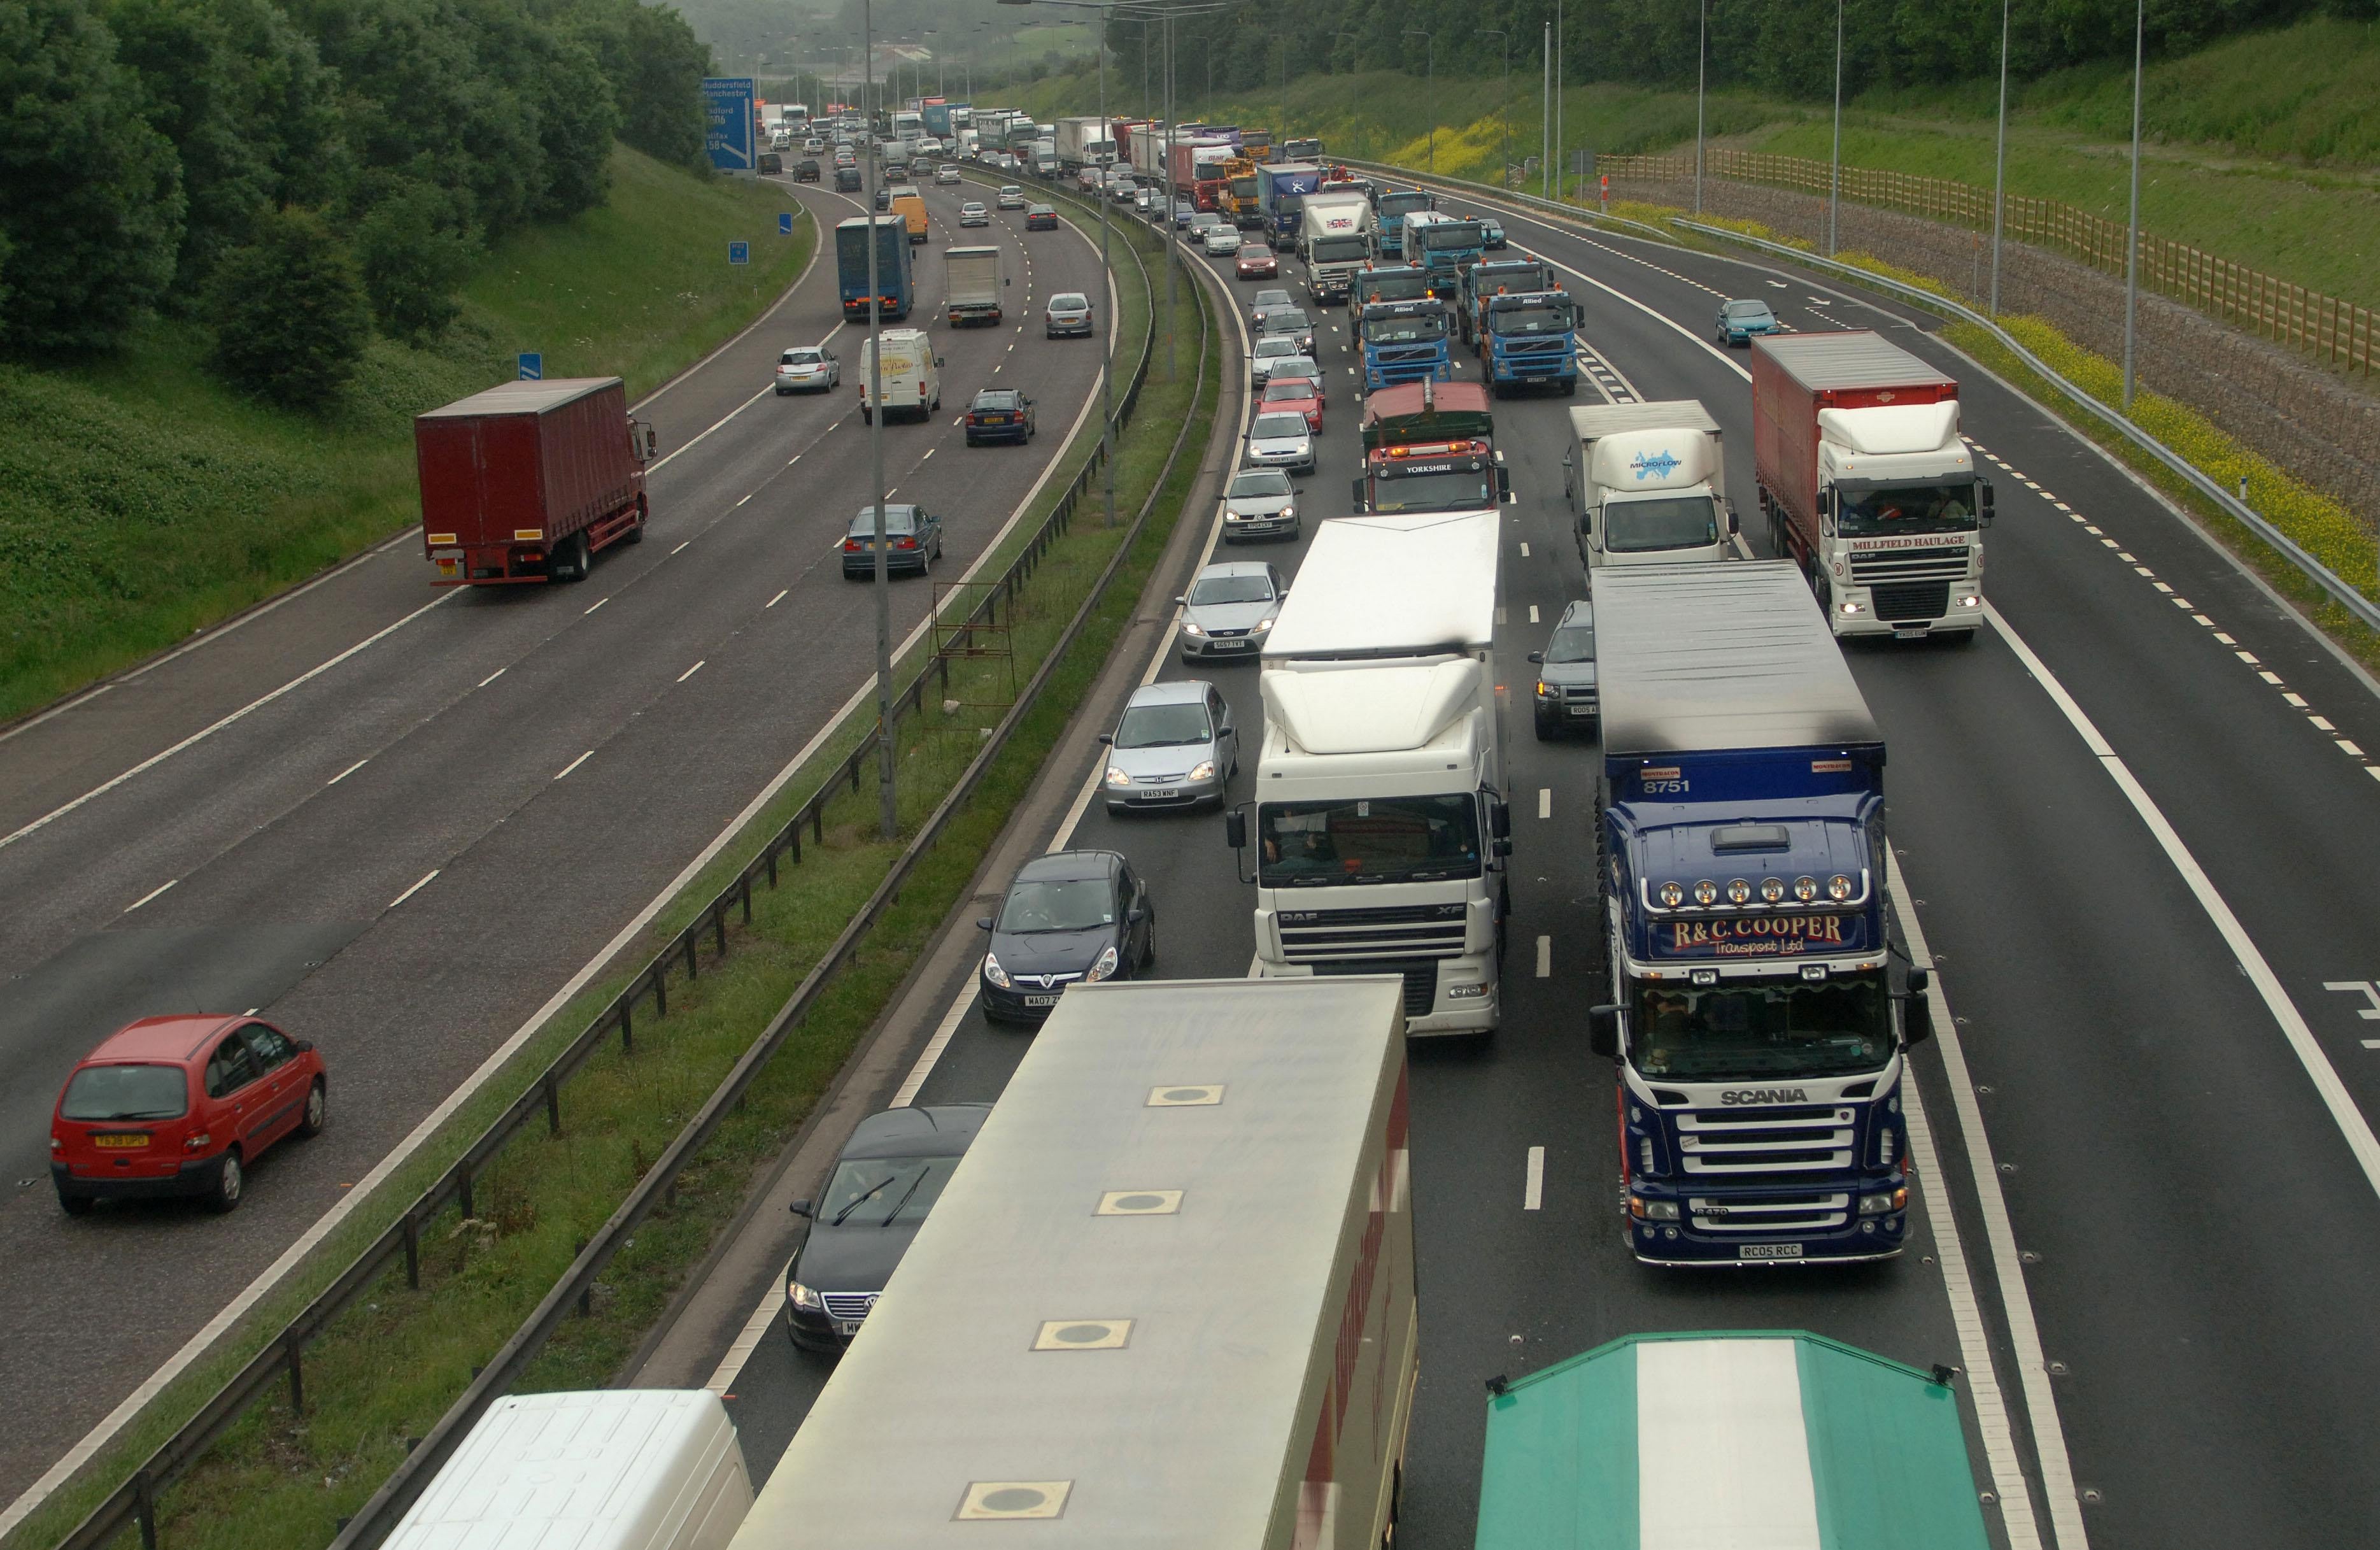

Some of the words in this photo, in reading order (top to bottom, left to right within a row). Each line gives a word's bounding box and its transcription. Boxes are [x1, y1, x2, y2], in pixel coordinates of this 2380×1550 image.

[1406, 464, 1452, 473] YORKSHIRE
[1630, 460, 1682, 469] MICROFLOW
[1853, 539, 1912, 550] MILLFIELD
[1915, 536, 1966, 547] HAULAGE
[1643, 779, 1690, 793] 8751
[1280, 913, 1318, 921] DAF
[1436, 906, 1464, 915] XF
[1735, 916, 1842, 942] COOPER
[1710, 939, 1777, 957] Transport
[1780, 937, 1805, 954] Ltd
[1721, 1088, 1808, 1106] SCANIA
[1745, 1247, 1773, 1256] RC05
[1776, 1246, 1797, 1256] RCC
